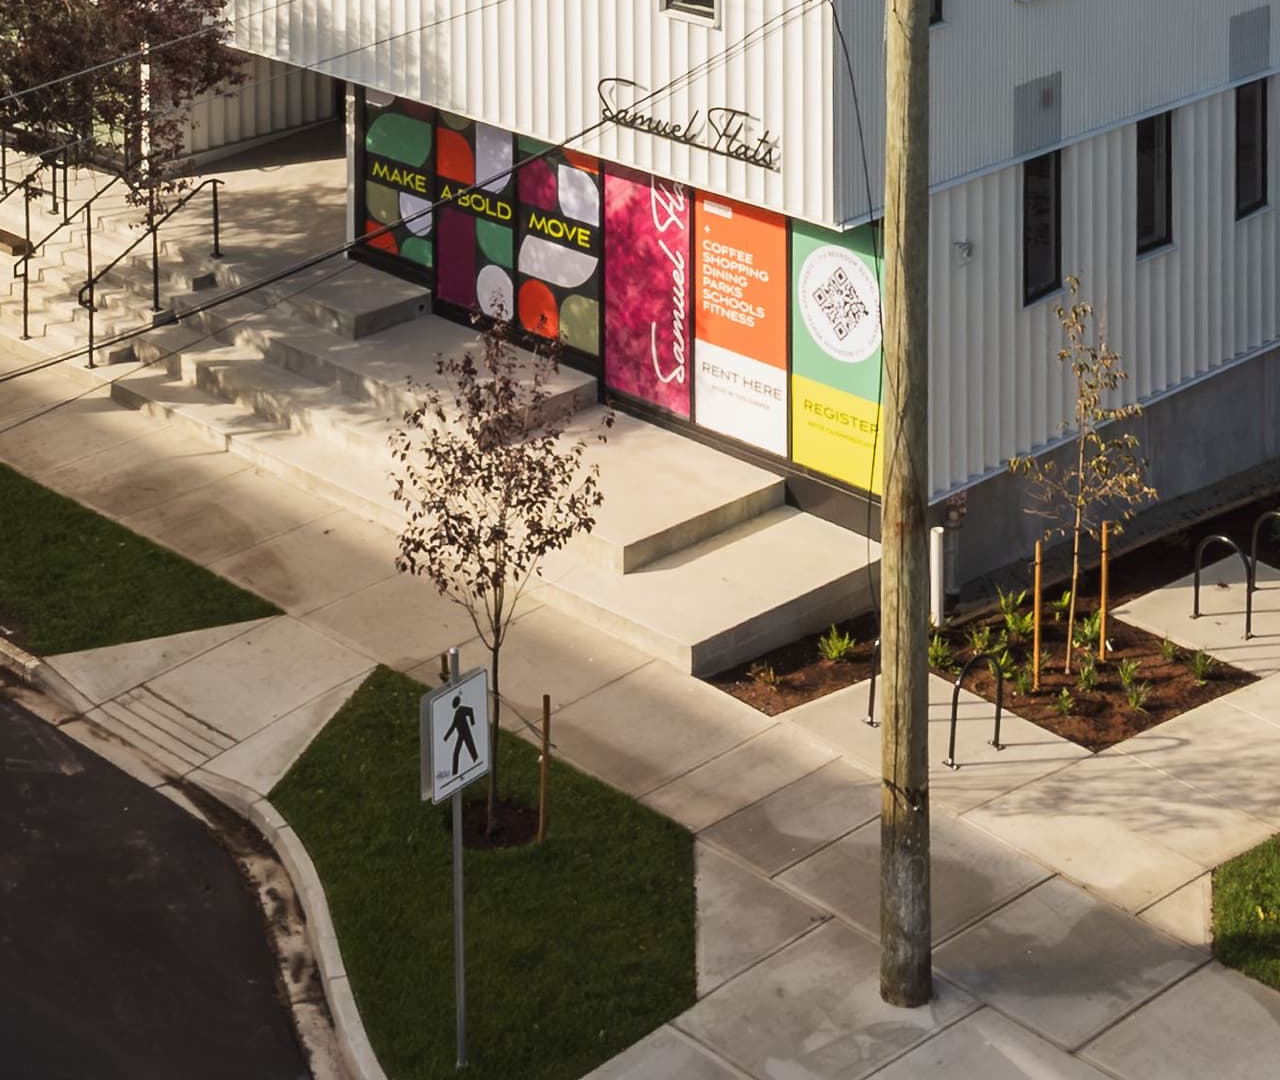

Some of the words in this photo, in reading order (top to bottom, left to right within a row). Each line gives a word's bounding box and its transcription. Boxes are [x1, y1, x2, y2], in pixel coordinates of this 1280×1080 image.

[598, 78, 700, 145] Samuel
[707, 107, 776, 169] Flats
[372, 162, 427, 193] MAKE
[440, 184, 453, 200] A
[457, 189, 512, 221] BOLD
[528, 212, 592, 249] MOVE
[702, 240, 753, 265] COFFEE
[702, 252, 769, 282] SHOPPING
[702, 264, 748, 288] DINING
[702, 276, 743, 299] PARKS
[651, 239, 686, 384] Samuel
[702, 288, 766, 319] SCHOOLS
[702, 302, 755, 328] FITNESS
[702, 361, 738, 384] RENT
[743, 376, 783, 401] HERE
